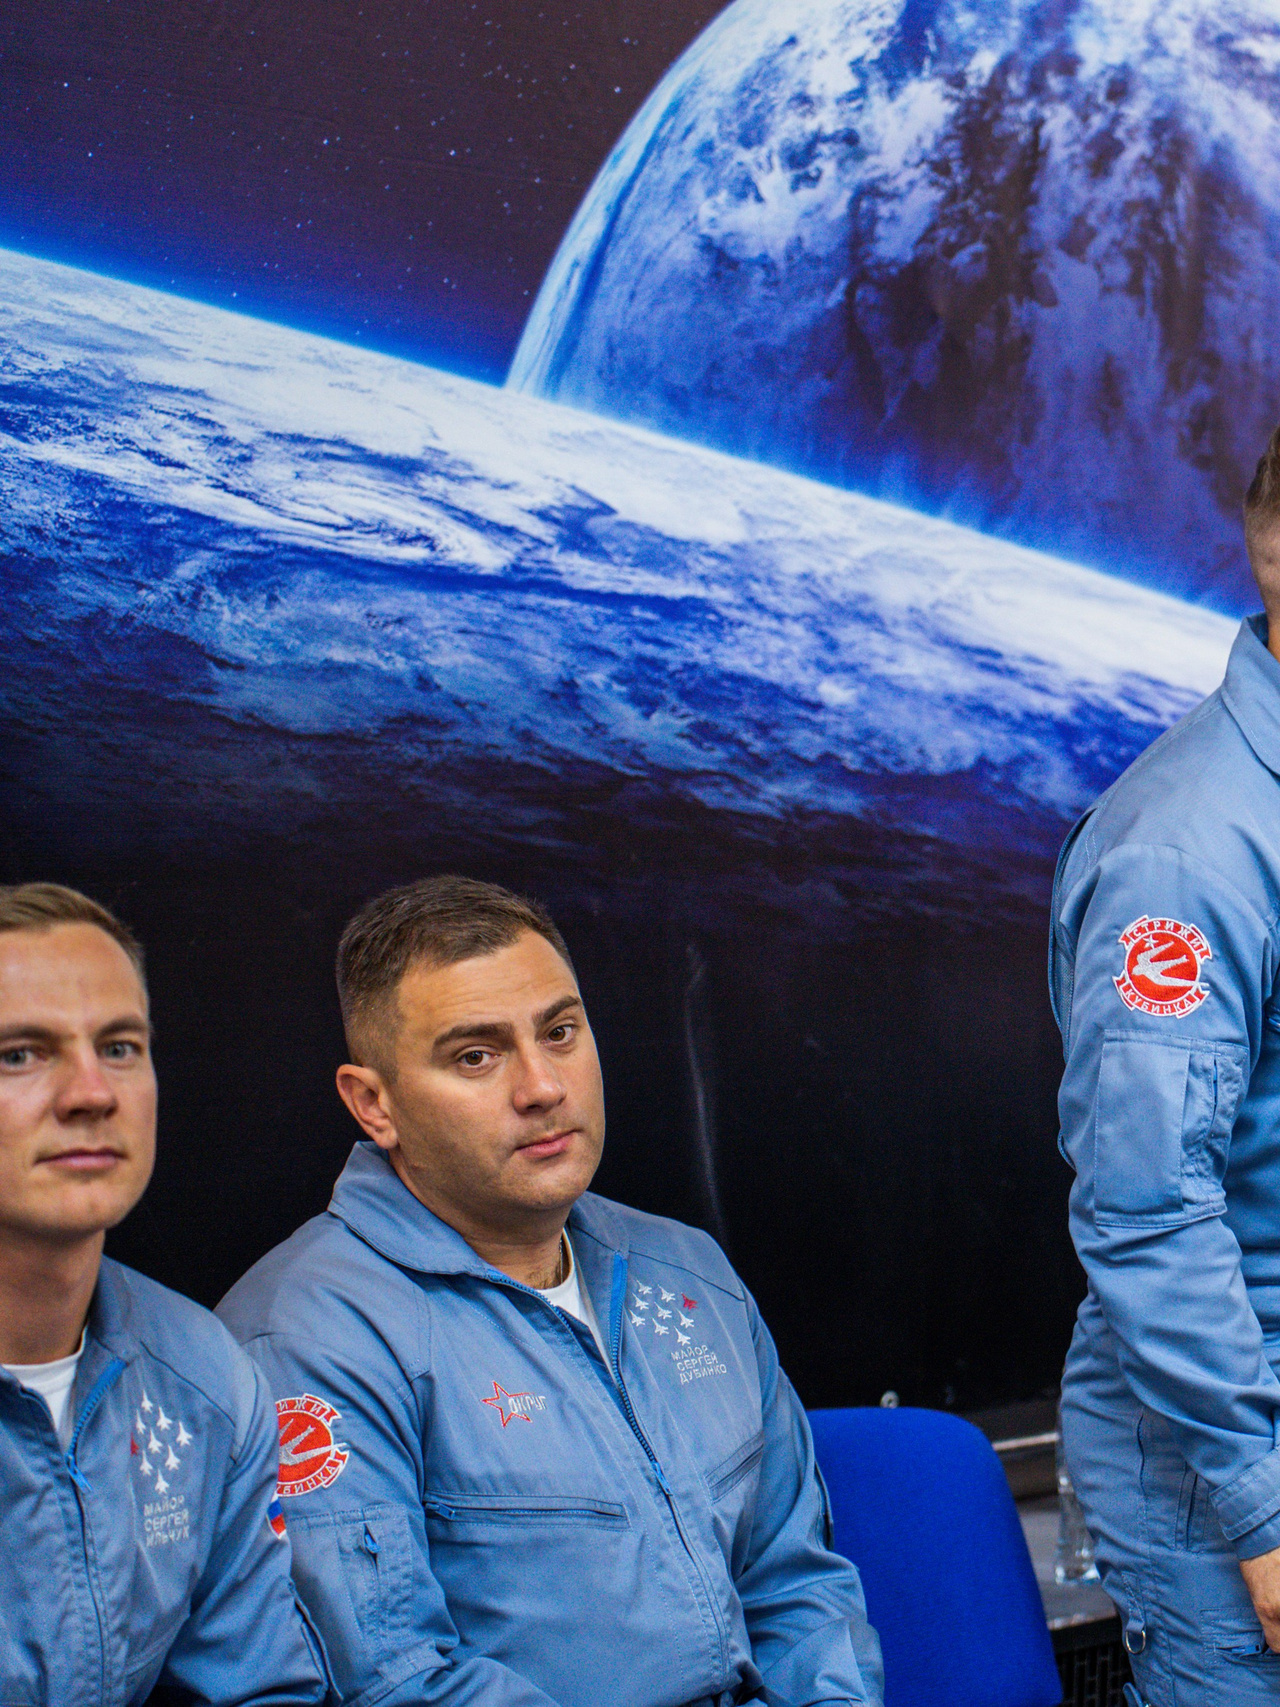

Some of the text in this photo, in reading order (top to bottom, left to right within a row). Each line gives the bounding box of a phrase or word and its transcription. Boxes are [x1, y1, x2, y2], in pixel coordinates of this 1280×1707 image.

[1133, 920, 1201, 948] СТРИЖИ
[1125, 989, 1193, 1014] КУБИНКА
[671, 1345, 708, 1361] МАЙОР
[677, 1351, 719, 1371] СЕРГЕЙ
[680, 1364, 727, 1385] ДУБИНКО
[278, 1399, 323, 1415] ИЖИ
[508, 1395, 546, 1413] ОКРУГ
[277, 1465, 336, 1494] БИНКА
[144, 1495, 185, 1516] МАЙОР
[144, 1508, 189, 1532] СЕРГЕЙ
